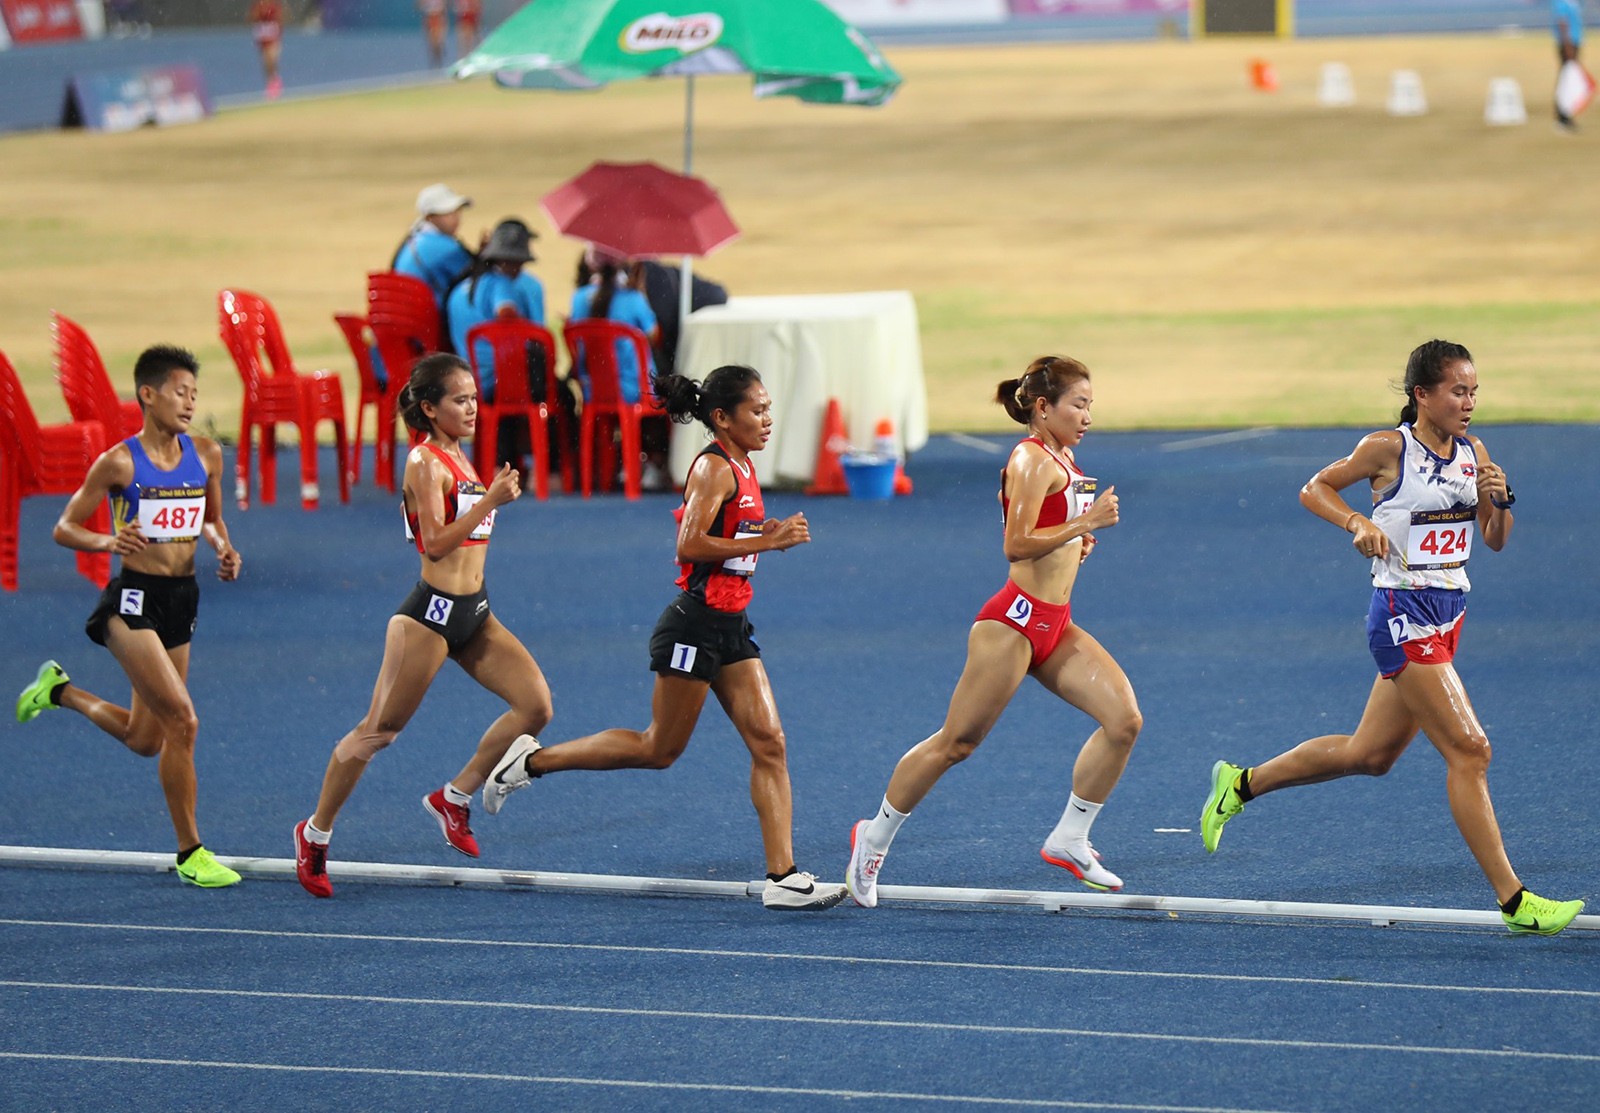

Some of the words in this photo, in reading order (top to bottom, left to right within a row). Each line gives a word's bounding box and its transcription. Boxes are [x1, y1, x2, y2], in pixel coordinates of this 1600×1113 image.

[636, 26, 710, 41] MILO
[152, 506, 201, 529] 487
[1419, 527, 1467, 555] 424
[124, 591, 139, 614] 5
[429, 598, 448, 622] 8
[1013, 599, 1030, 620] 9
[1392, 618, 1408, 643] 2
[678, 646, 689, 670] 1
